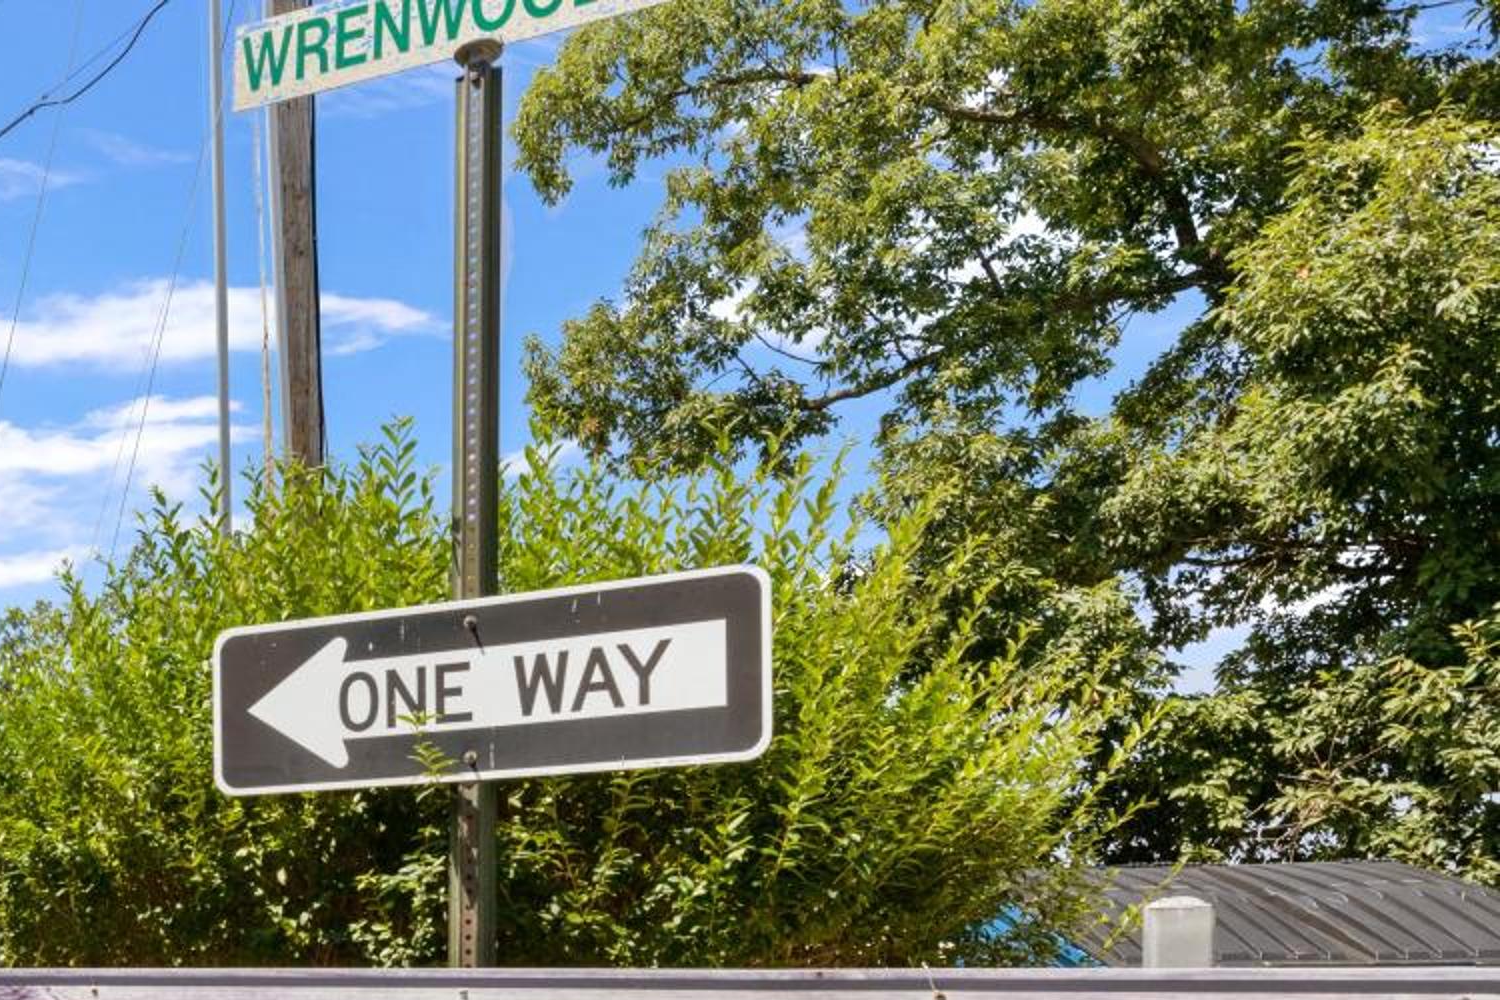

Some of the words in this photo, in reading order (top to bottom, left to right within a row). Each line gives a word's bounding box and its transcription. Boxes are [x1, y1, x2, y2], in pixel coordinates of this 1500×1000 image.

[243, 0, 599, 92] WRENWO
[338, 661, 474, 732] ONE
[513, 638, 673, 717] WAY
